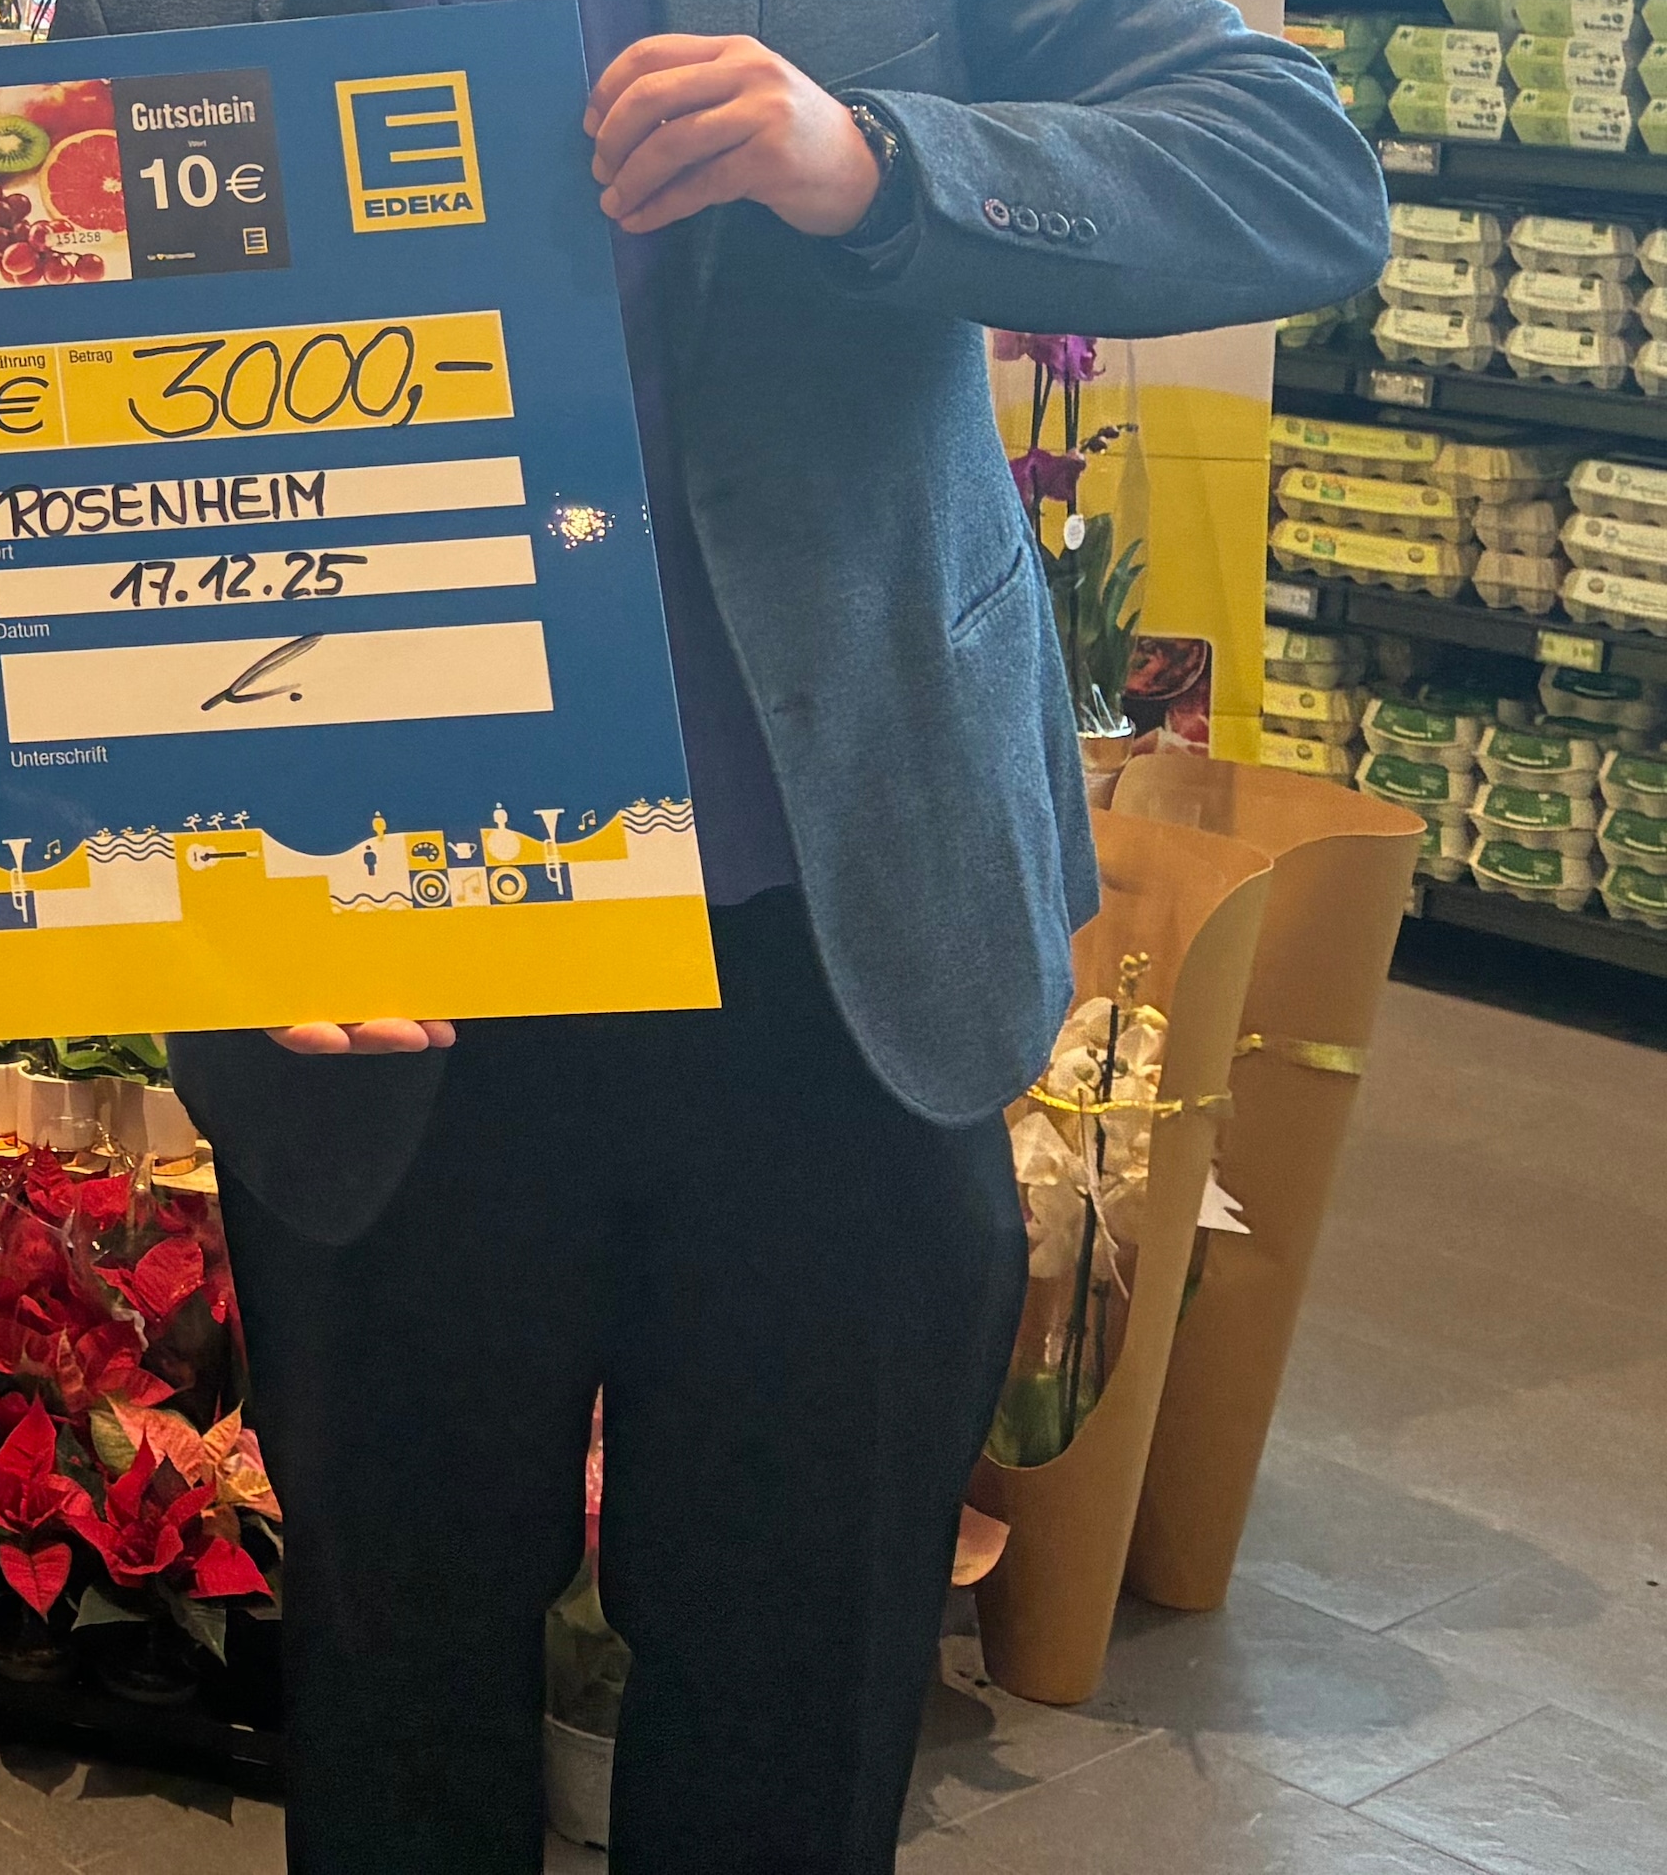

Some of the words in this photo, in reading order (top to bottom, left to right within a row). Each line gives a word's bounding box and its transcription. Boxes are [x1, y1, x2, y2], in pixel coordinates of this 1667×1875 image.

[131, 95, 256, 131] Gutschein
[139, 154, 267, 210] 10€
[364, 192, 473, 218] EDEKA
[56, 232, 101, 245] 151258
[68, 347, 113, 365] Betrag
[128, 326, 493, 438] 3000,-
[110, 551, 368, 608] 17.12.25
[10, 745, 109, 768] Unterschrift
